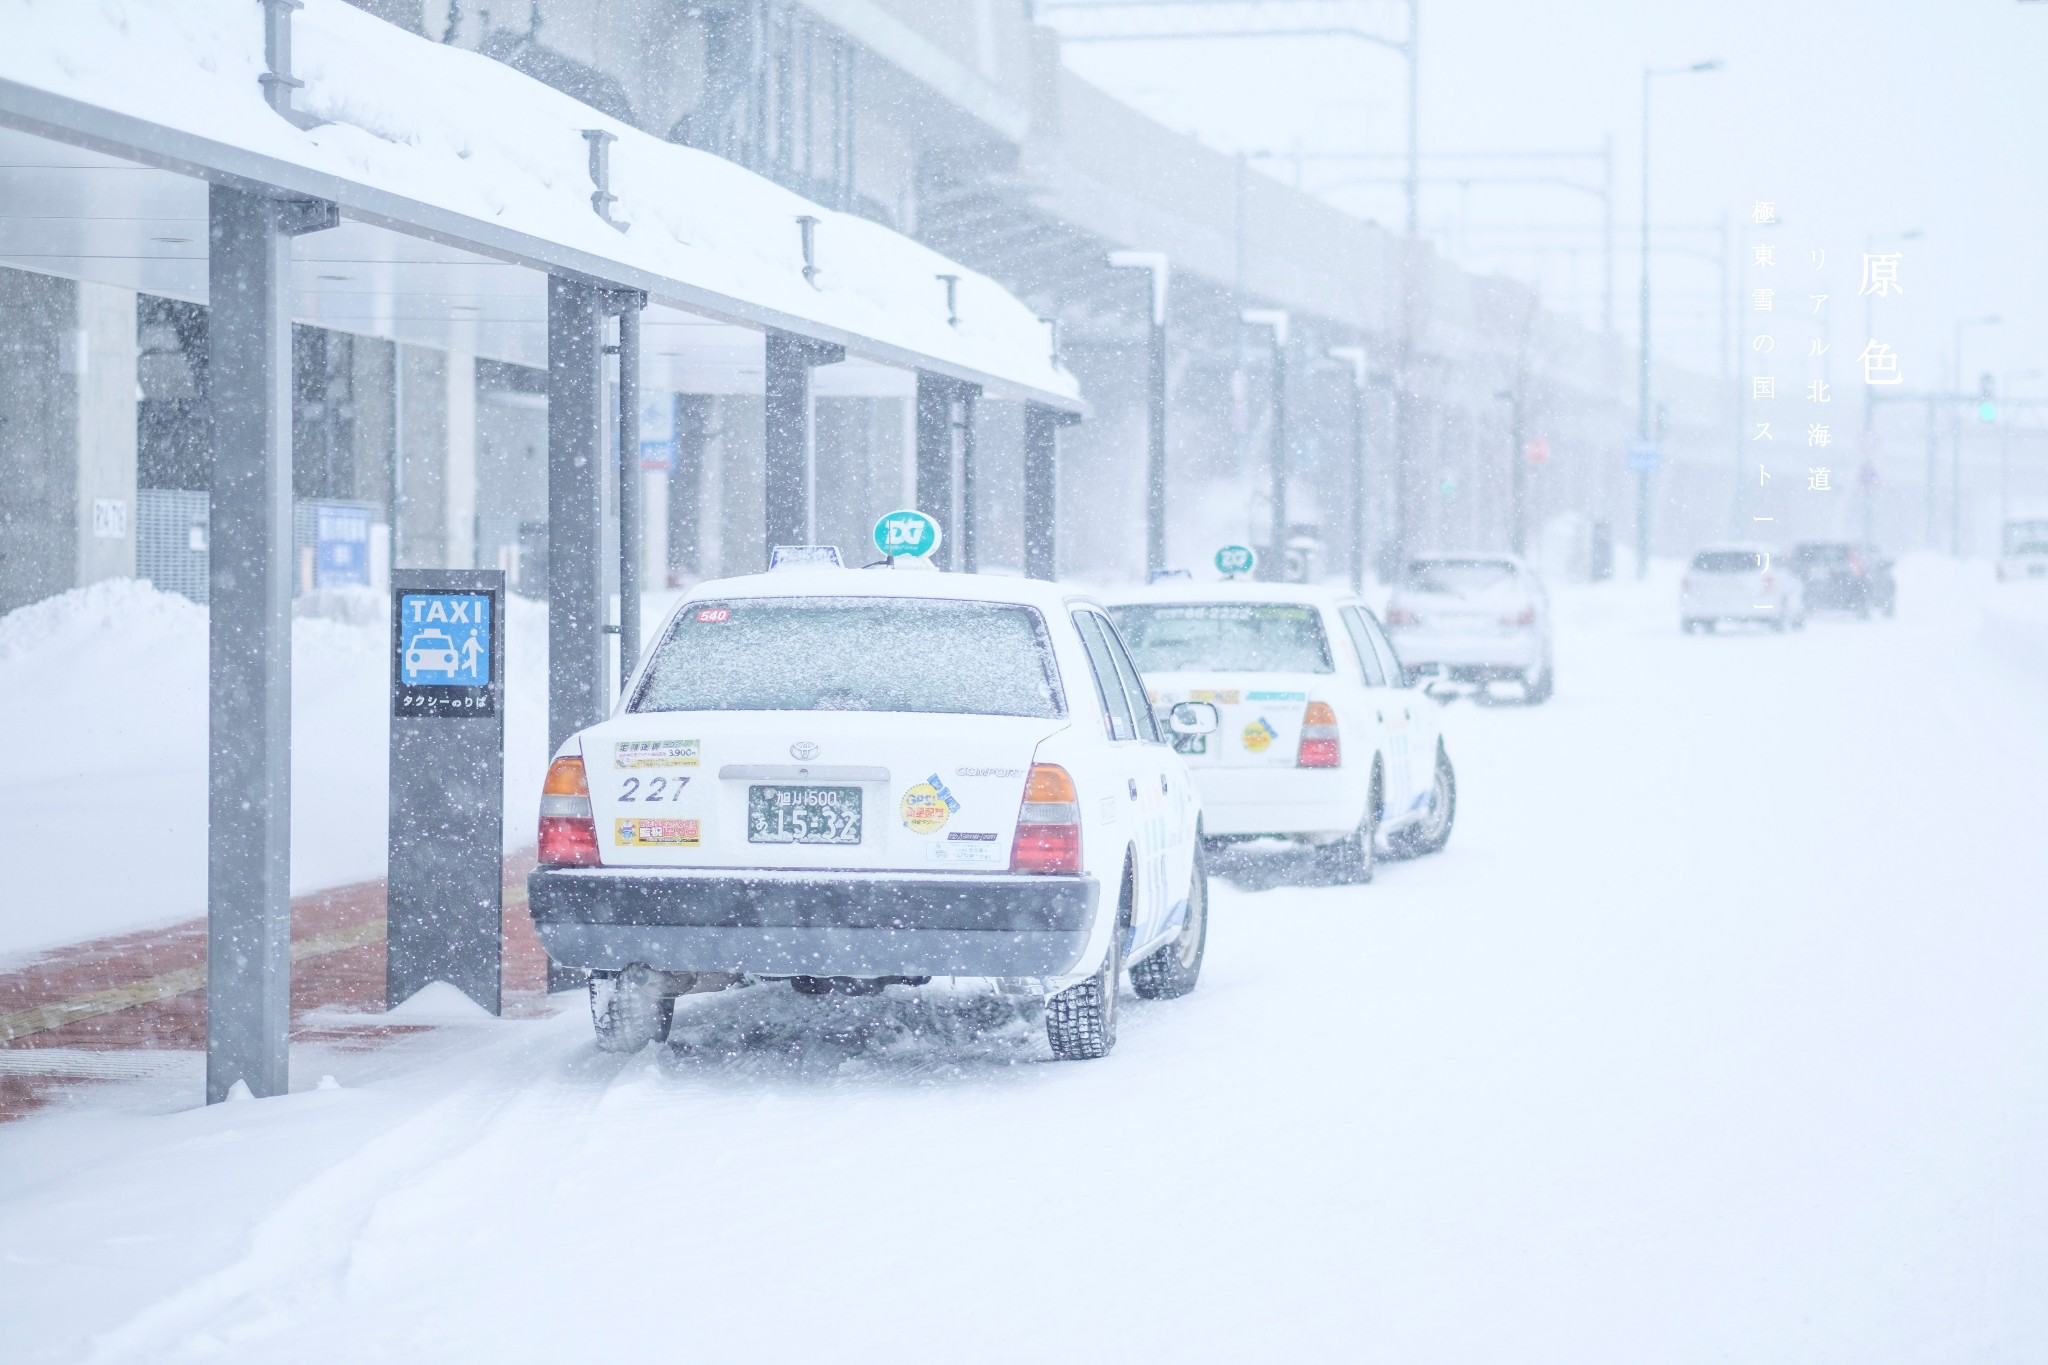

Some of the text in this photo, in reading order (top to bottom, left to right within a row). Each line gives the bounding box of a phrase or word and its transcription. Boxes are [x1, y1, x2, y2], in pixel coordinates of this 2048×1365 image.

[409, 600, 482, 624] TAXI
[700, 610, 727, 621] 540
[403, 695, 488, 708] タクシーのりば
[956, 767, 1025, 778] COMFORT
[618, 776, 691, 802] 227
[776, 790, 837, 806] 旭川500
